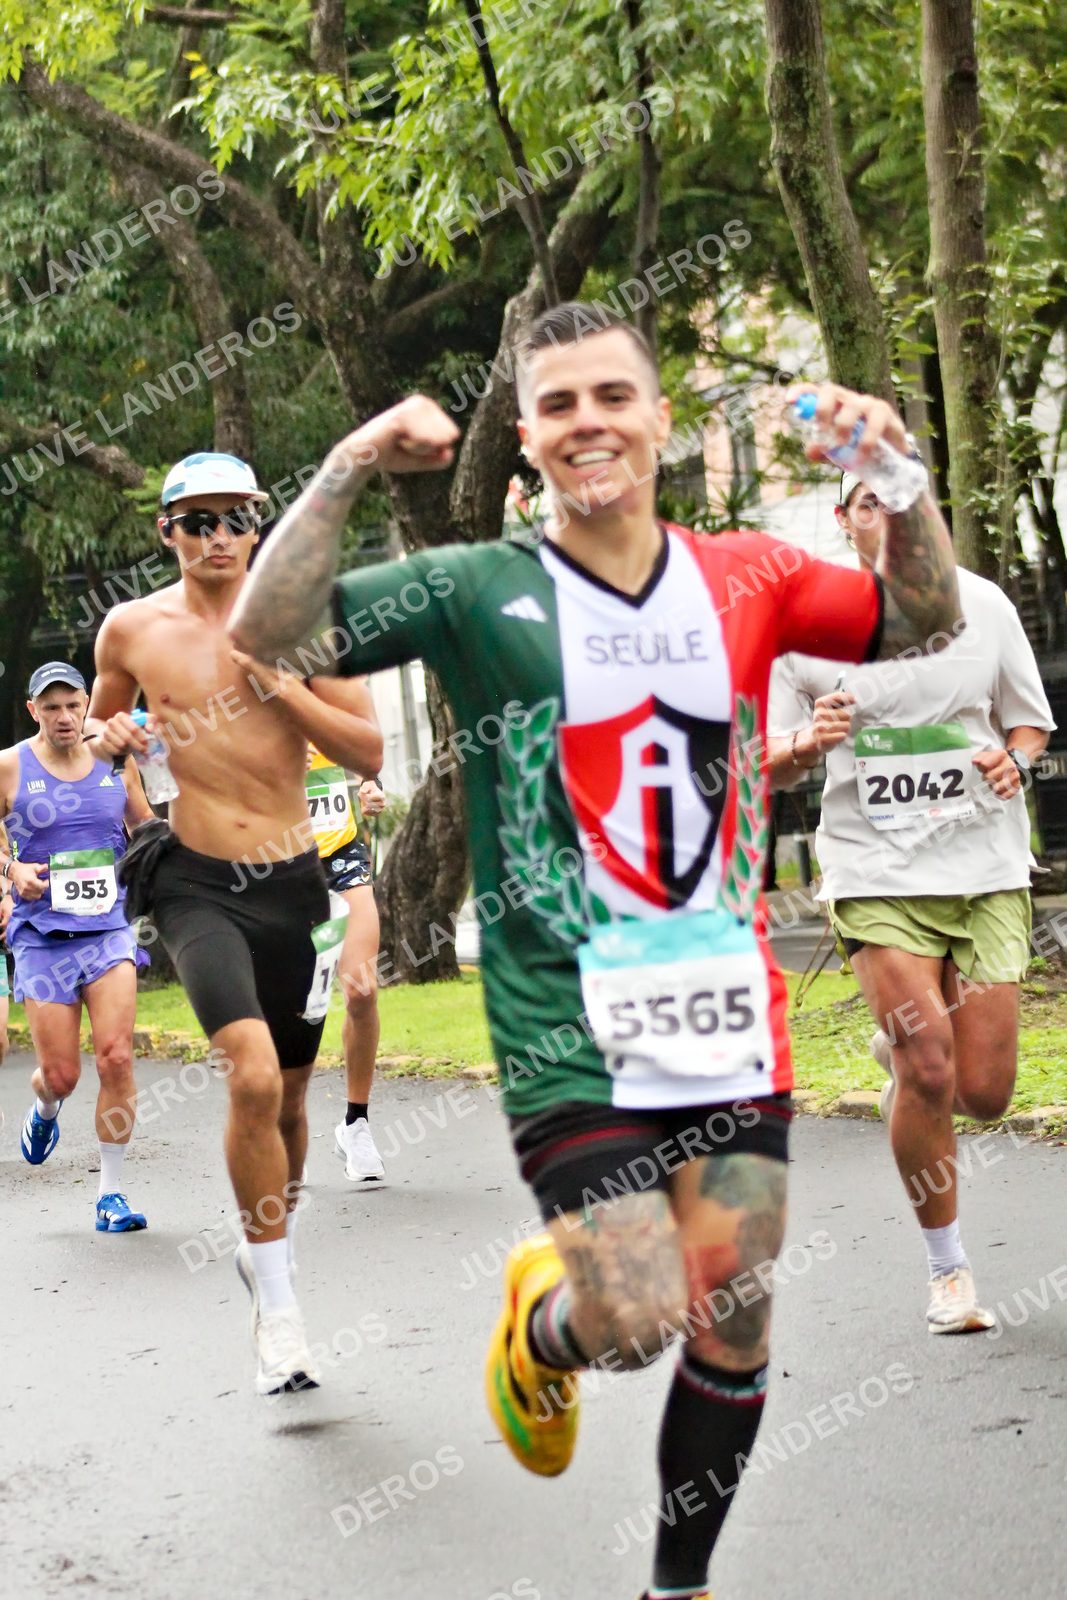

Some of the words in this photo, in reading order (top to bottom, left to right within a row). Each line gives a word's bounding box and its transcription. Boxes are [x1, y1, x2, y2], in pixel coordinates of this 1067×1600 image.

[586, 629, 708, 666] SEULE
[866, 769, 964, 805] 2042
[308, 795, 346, 817] 710
[65, 879, 108, 900] 953
[608, 987, 756, 1041] 5565
